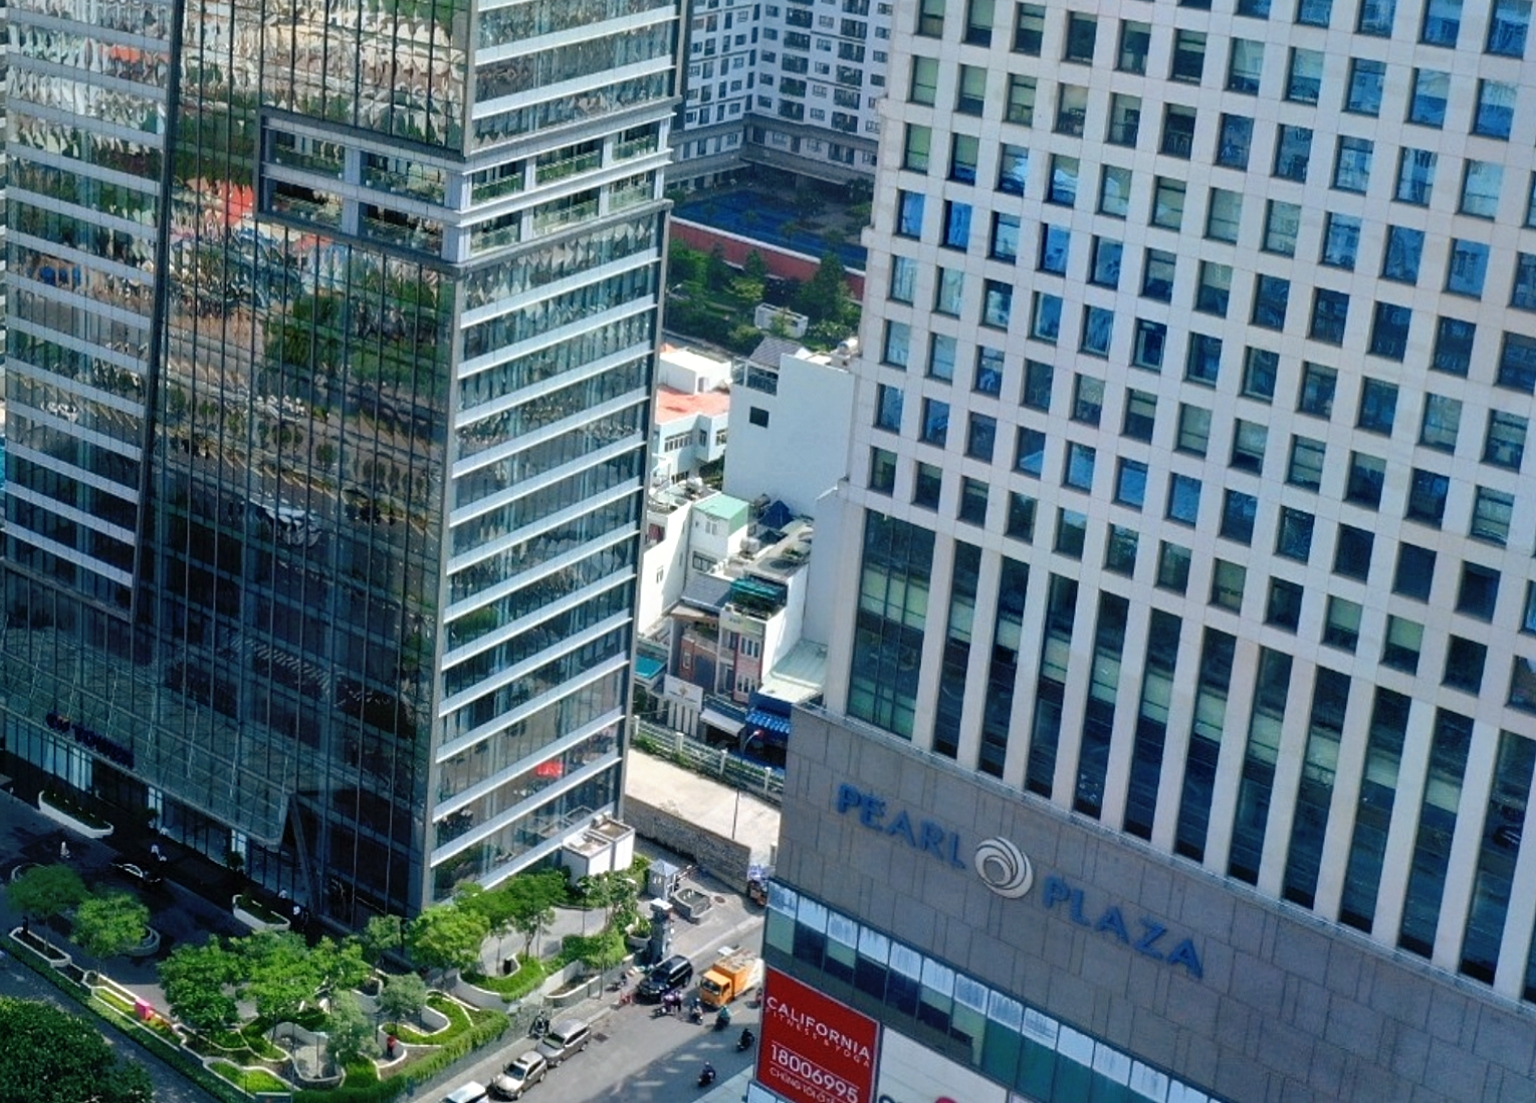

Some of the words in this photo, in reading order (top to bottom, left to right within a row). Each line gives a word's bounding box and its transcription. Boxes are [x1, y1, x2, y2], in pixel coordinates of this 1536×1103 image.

[836, 783, 967, 869] PEARL
[1041, 875, 1204, 979] PLAZA
[765, 1006, 818, 1040] FITNESS
[835, 1045, 870, 1068] YOGA
[767, 996, 870, 1060] CALIFORNIA
[771, 1044, 859, 1103] 18006995
